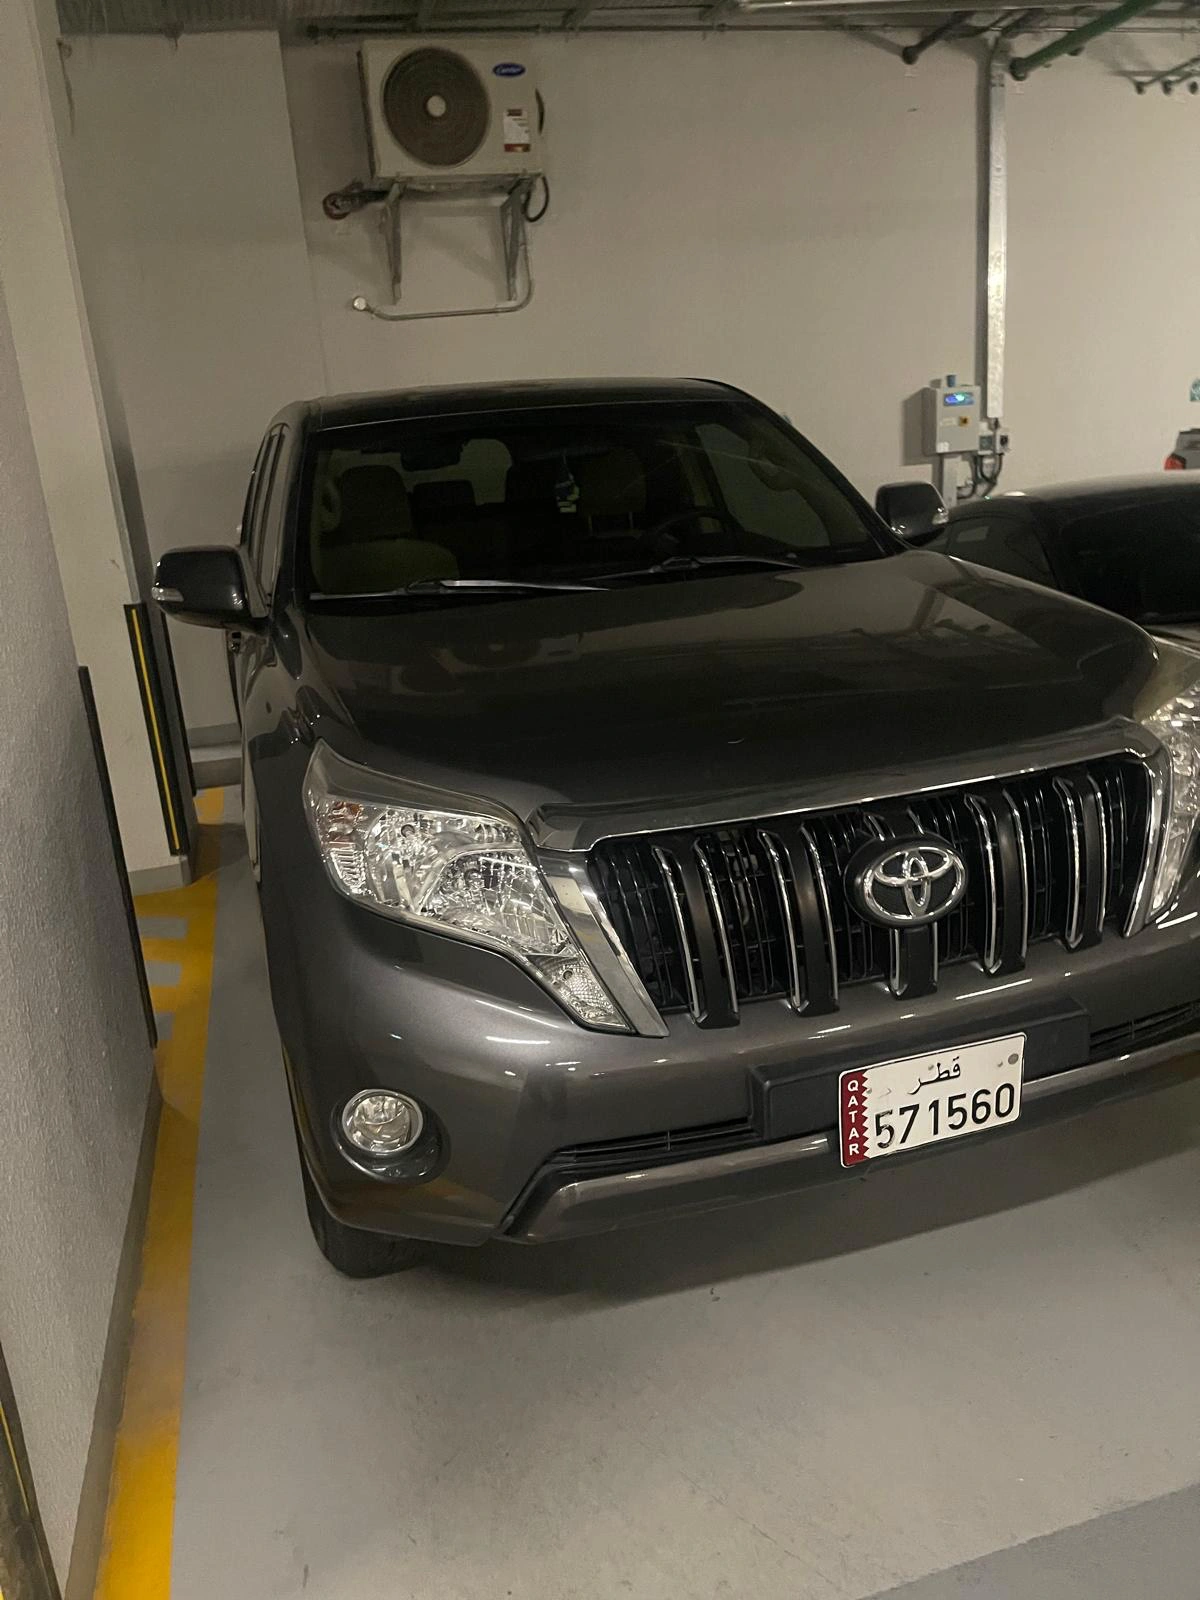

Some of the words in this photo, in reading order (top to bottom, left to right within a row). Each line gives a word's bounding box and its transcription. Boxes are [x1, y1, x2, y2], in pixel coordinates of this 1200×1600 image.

[907, 1056, 962, 1095] قطر
[847, 1079, 860, 1156] QATAR
[874, 1082, 1015, 1149] 571560
